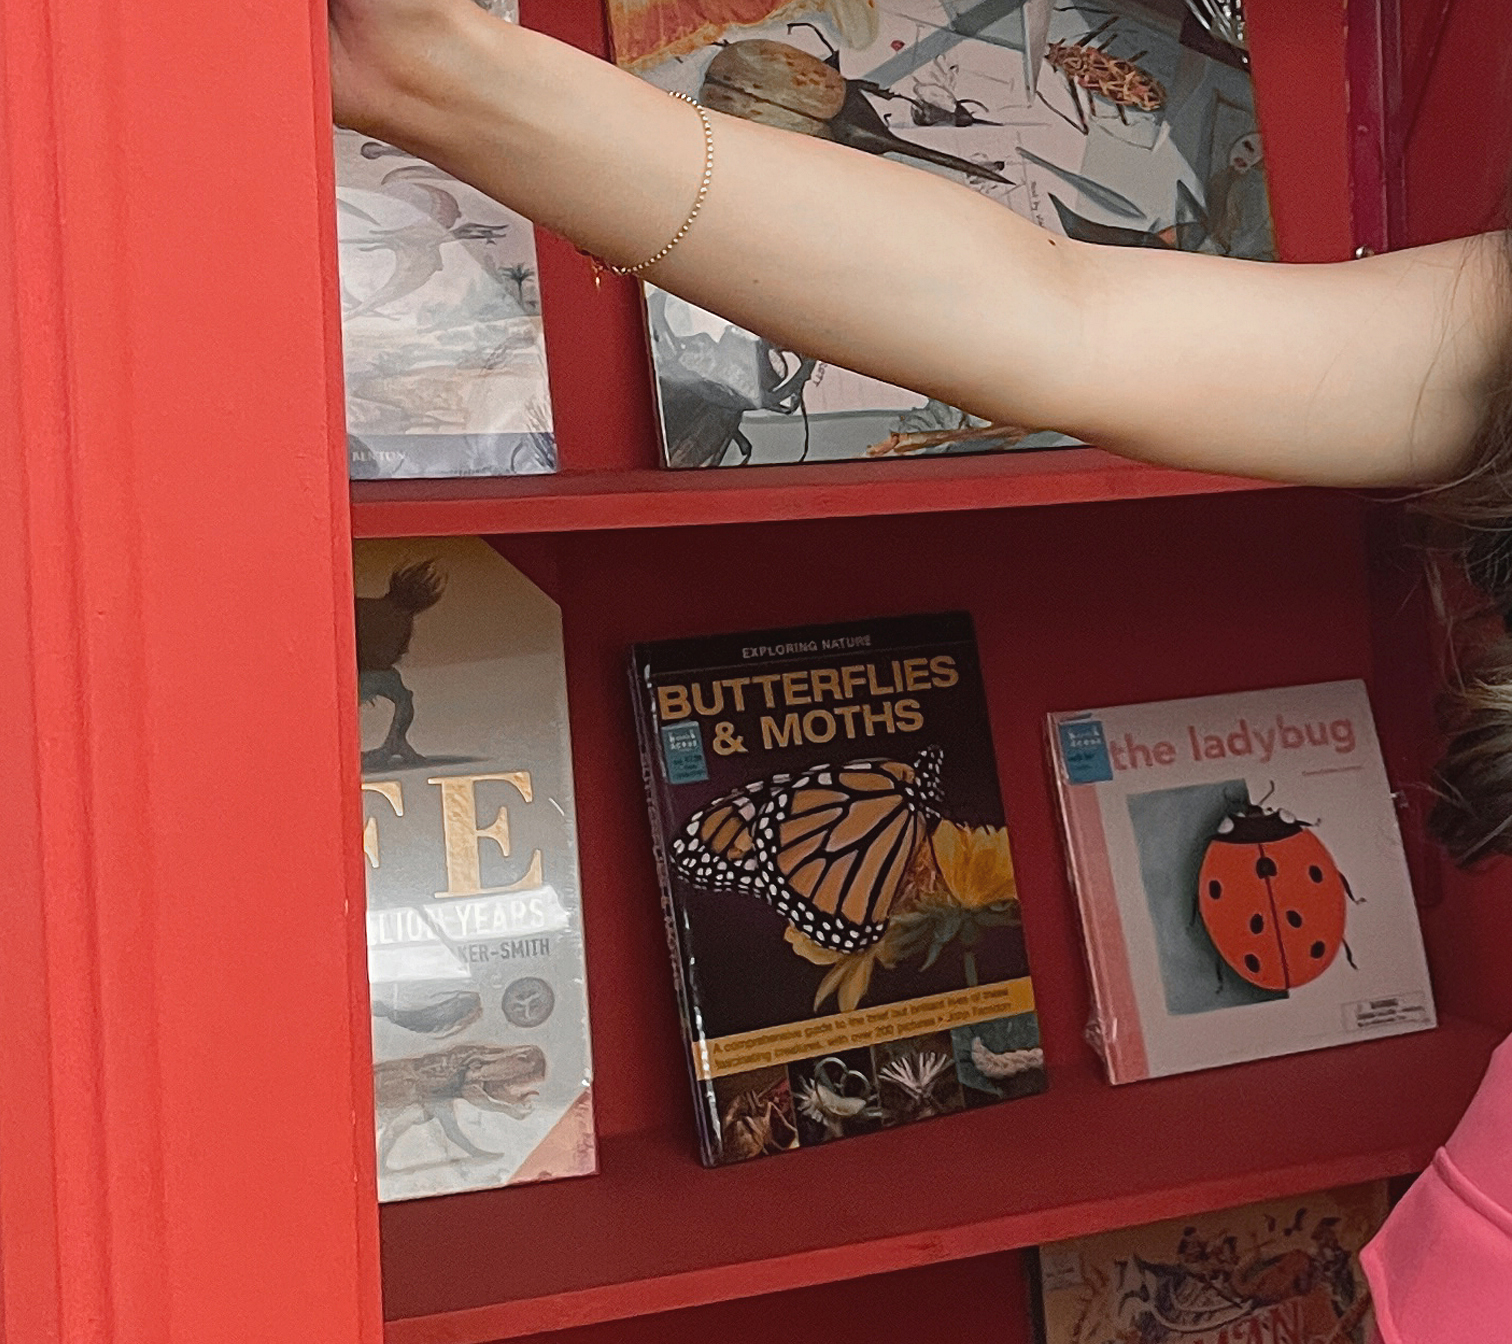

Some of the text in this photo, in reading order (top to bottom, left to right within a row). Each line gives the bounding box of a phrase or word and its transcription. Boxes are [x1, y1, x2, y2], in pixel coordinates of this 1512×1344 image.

[742, 634, 871, 659] EXPLORING NATURE
[657, 656, 959, 720] BUTTERFLIES
[712, 699, 924, 756] & MOTHS
[1109, 732, 1178, 771] the
[1187, 714, 1357, 763] ladybug
[454, 899, 545, 937] YEARS
